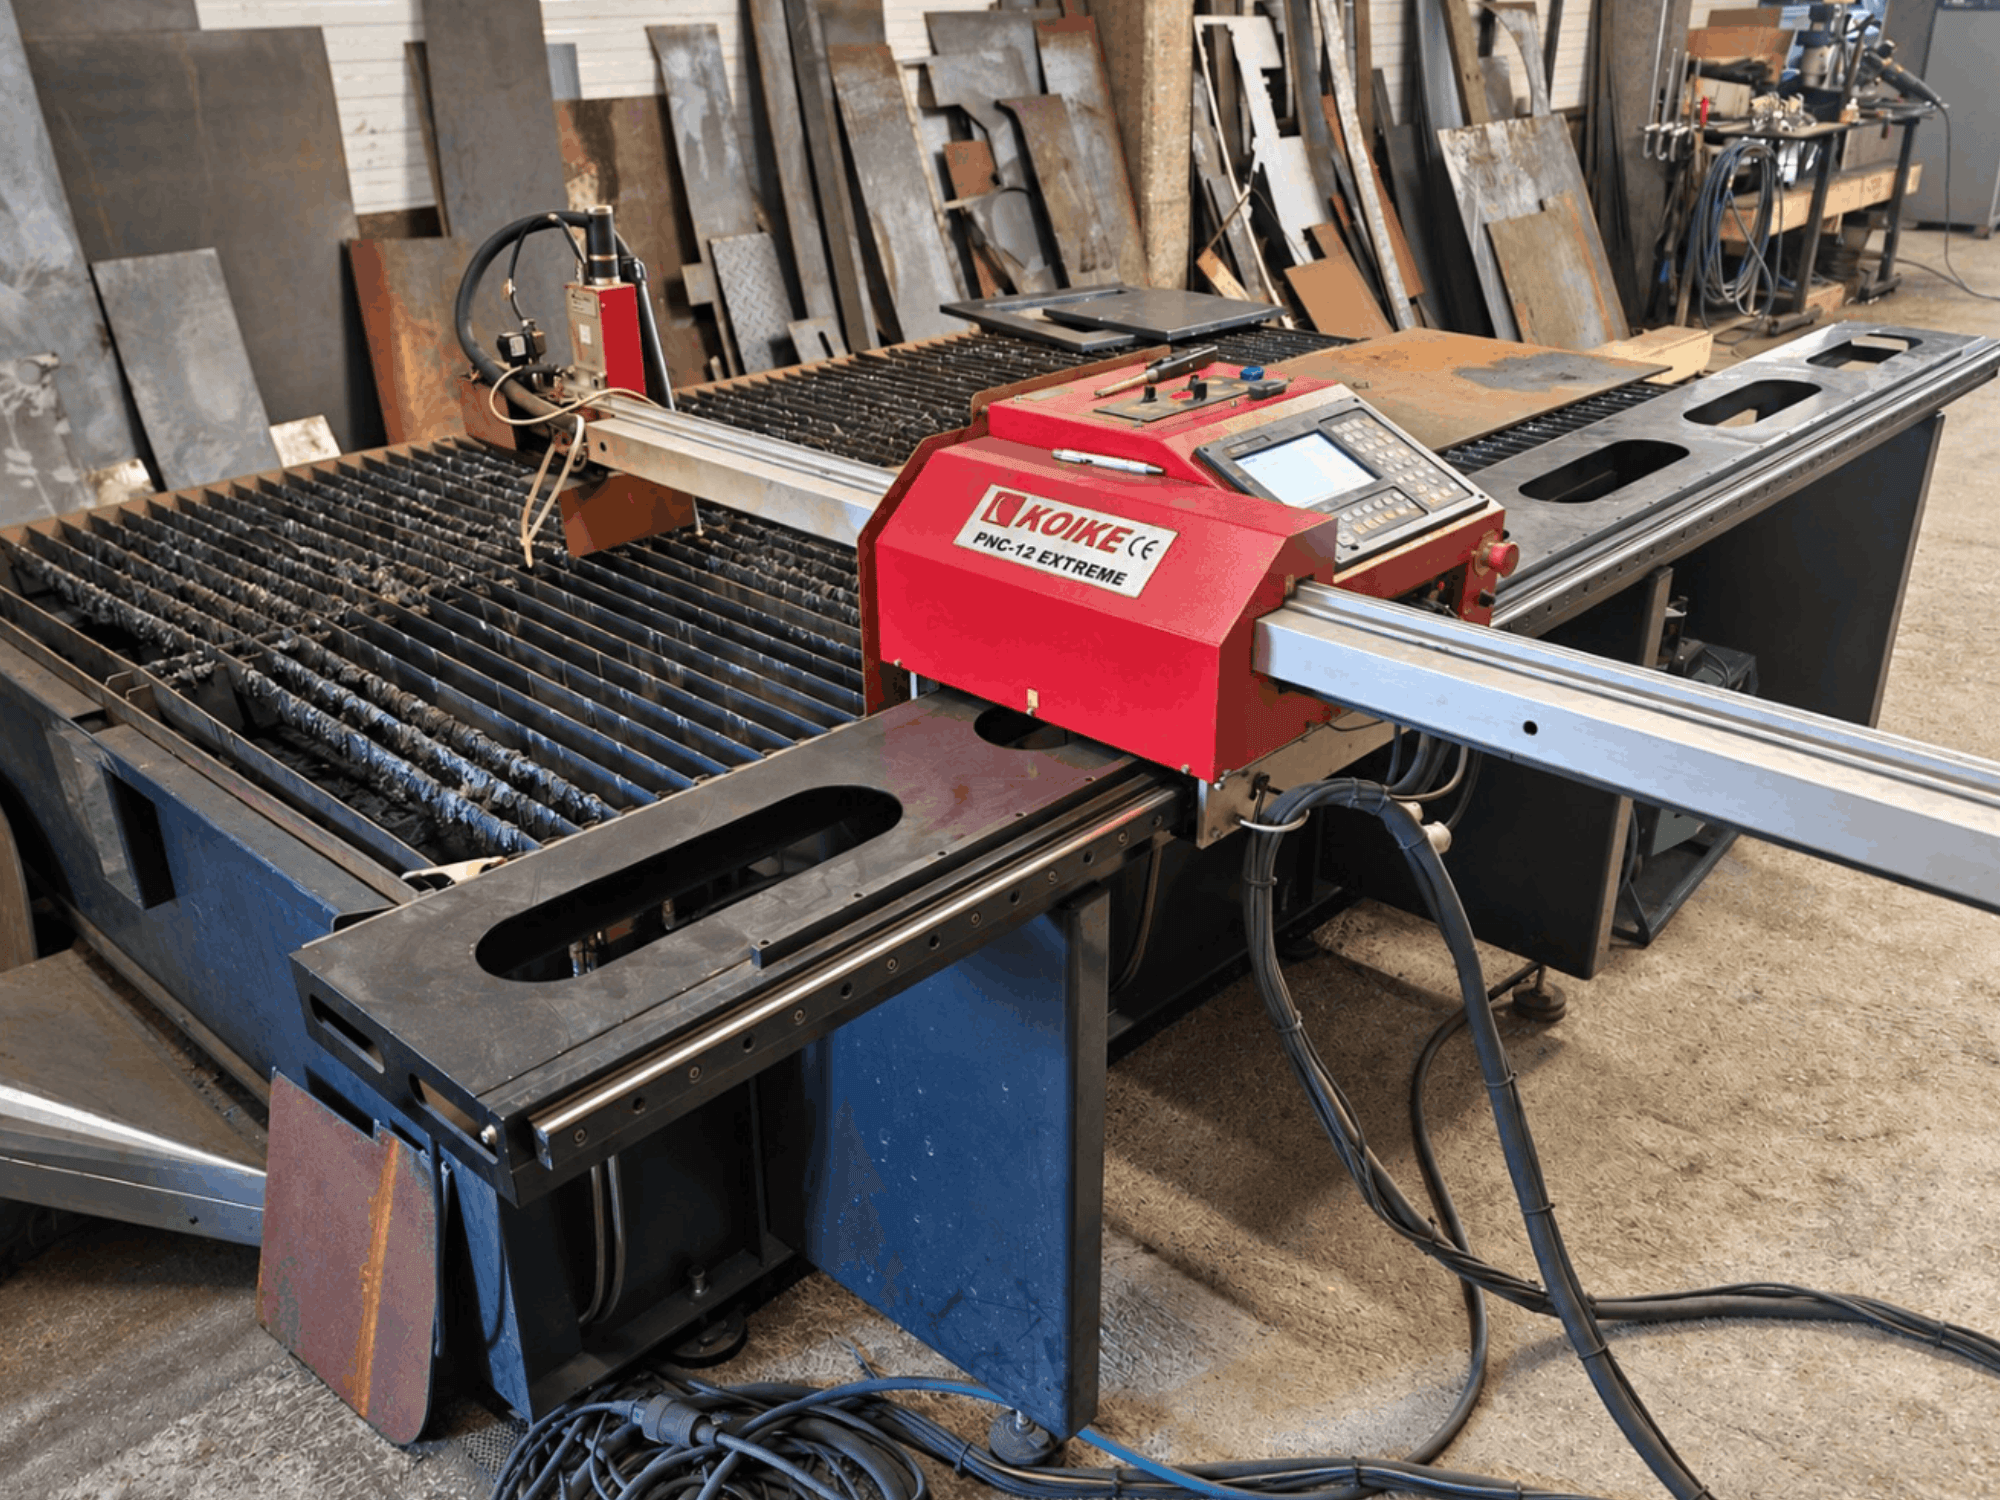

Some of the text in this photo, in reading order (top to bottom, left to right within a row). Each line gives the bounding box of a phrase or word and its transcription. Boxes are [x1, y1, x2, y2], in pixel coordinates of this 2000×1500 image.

[1014, 504, 1134, 554] KOIKE
[1127, 536, 1160, 561] CE
[972, 531, 1128, 587] PNC-12 EXTREME
